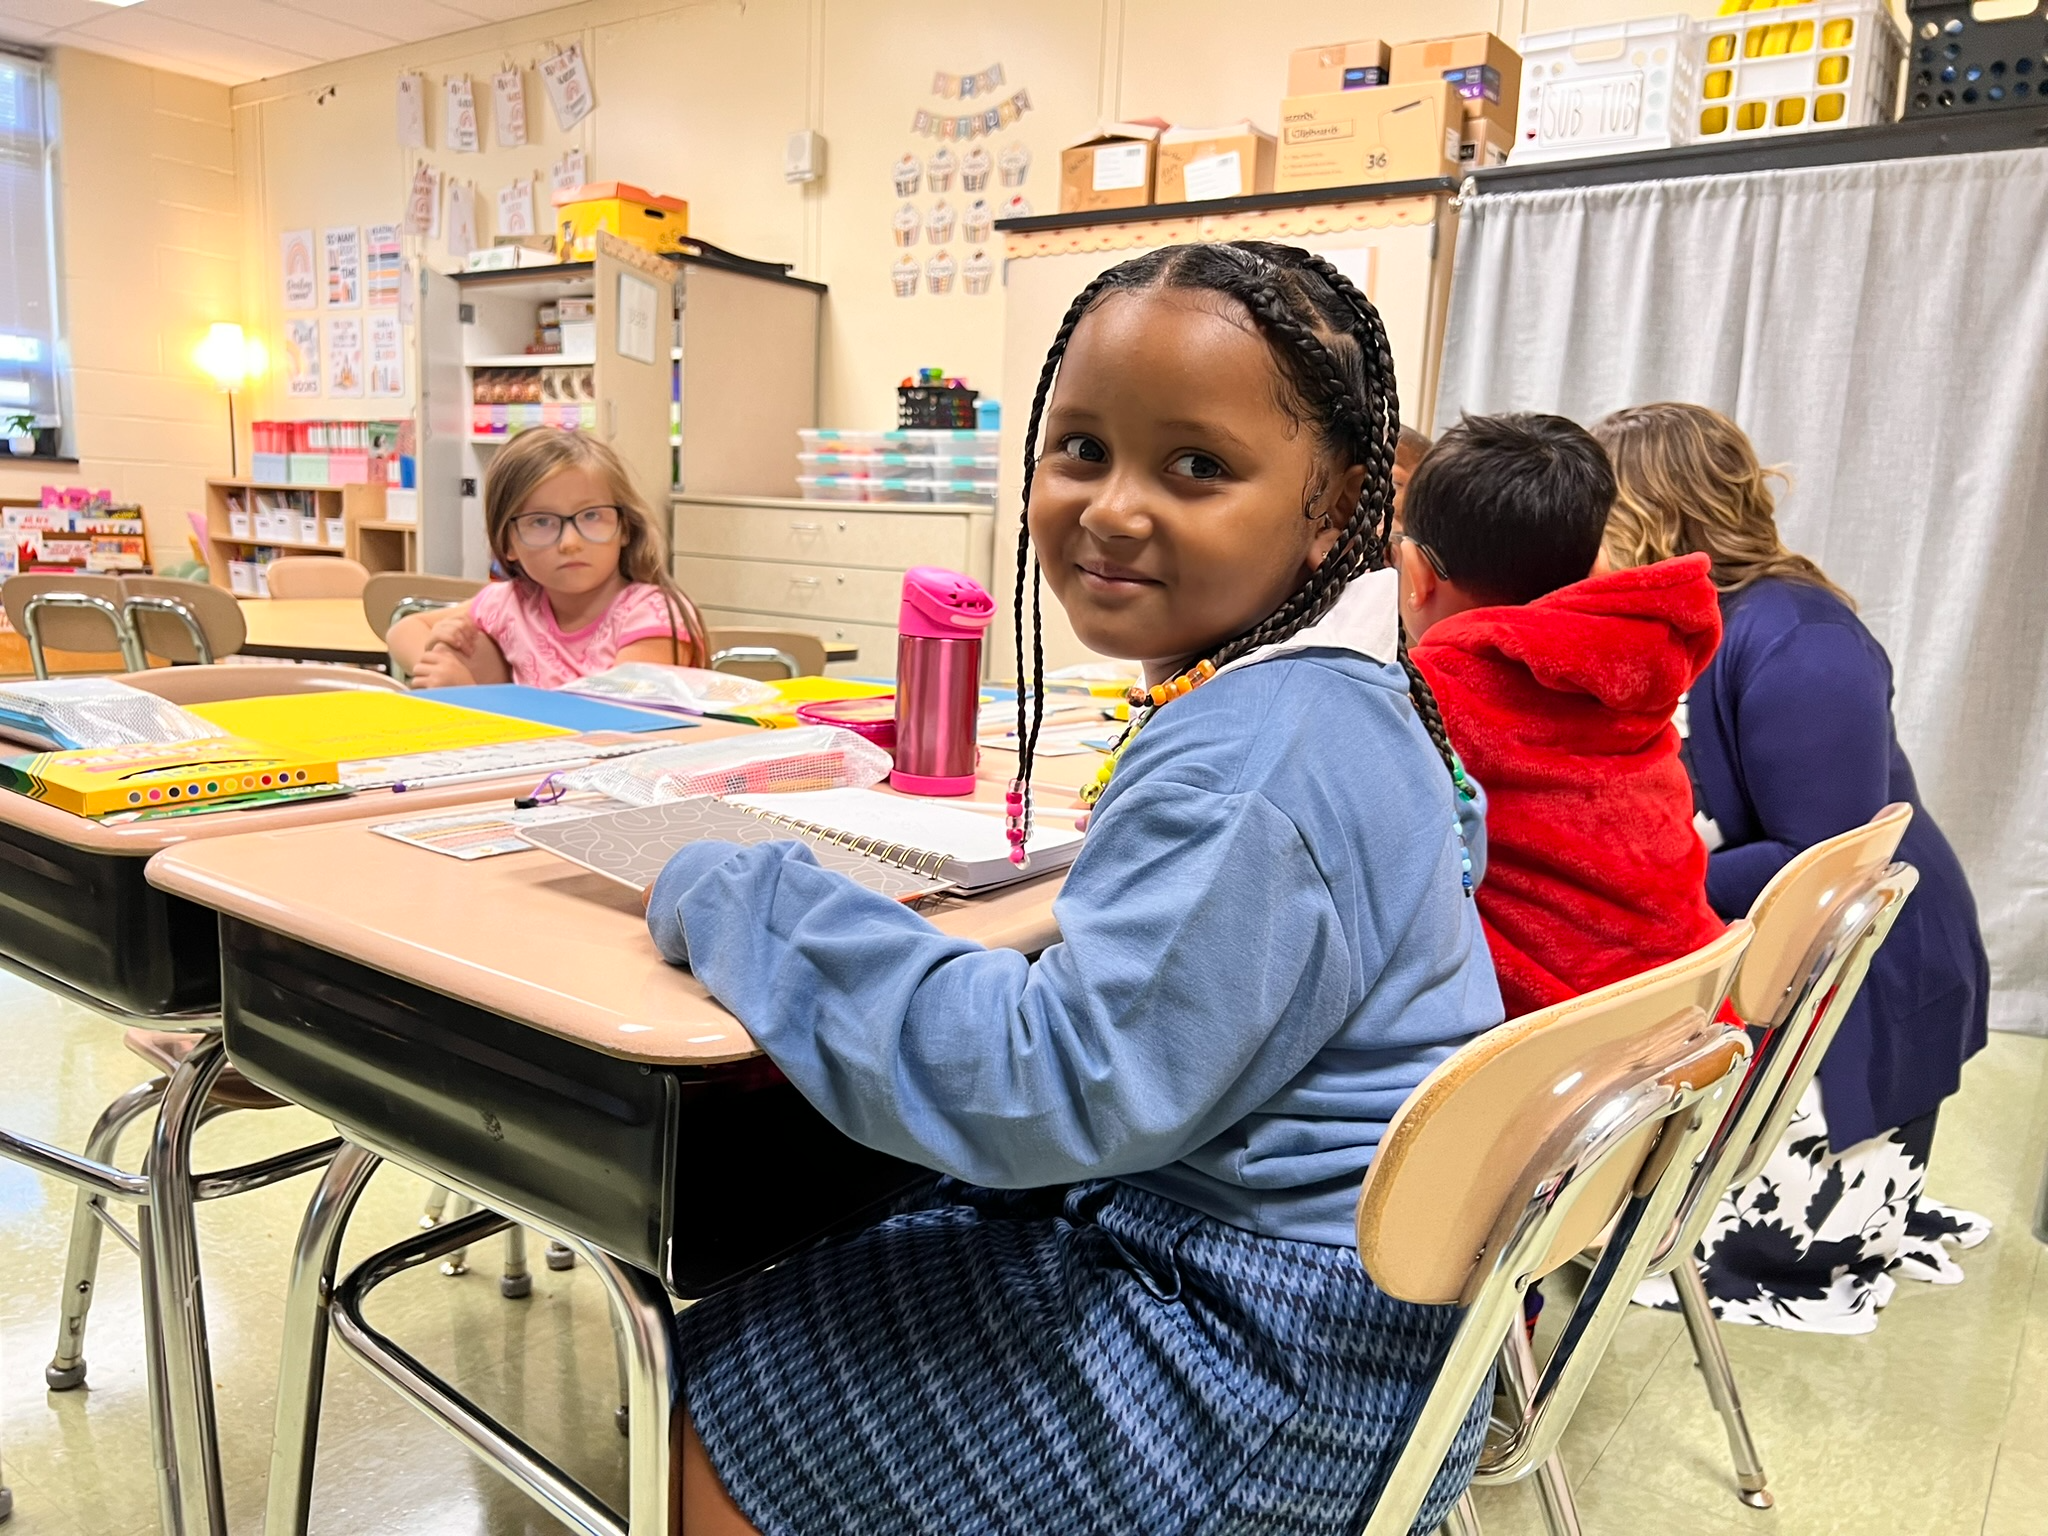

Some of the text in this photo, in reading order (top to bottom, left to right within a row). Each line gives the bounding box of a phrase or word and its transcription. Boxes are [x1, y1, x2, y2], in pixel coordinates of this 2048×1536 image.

[1543, 80, 1582, 138] SUB
[1600, 76, 1636, 134] TUB
[1366, 153, 1388, 169] 36
[337, 233, 356, 243] MANY
[341, 267, 357, 279] TIME
